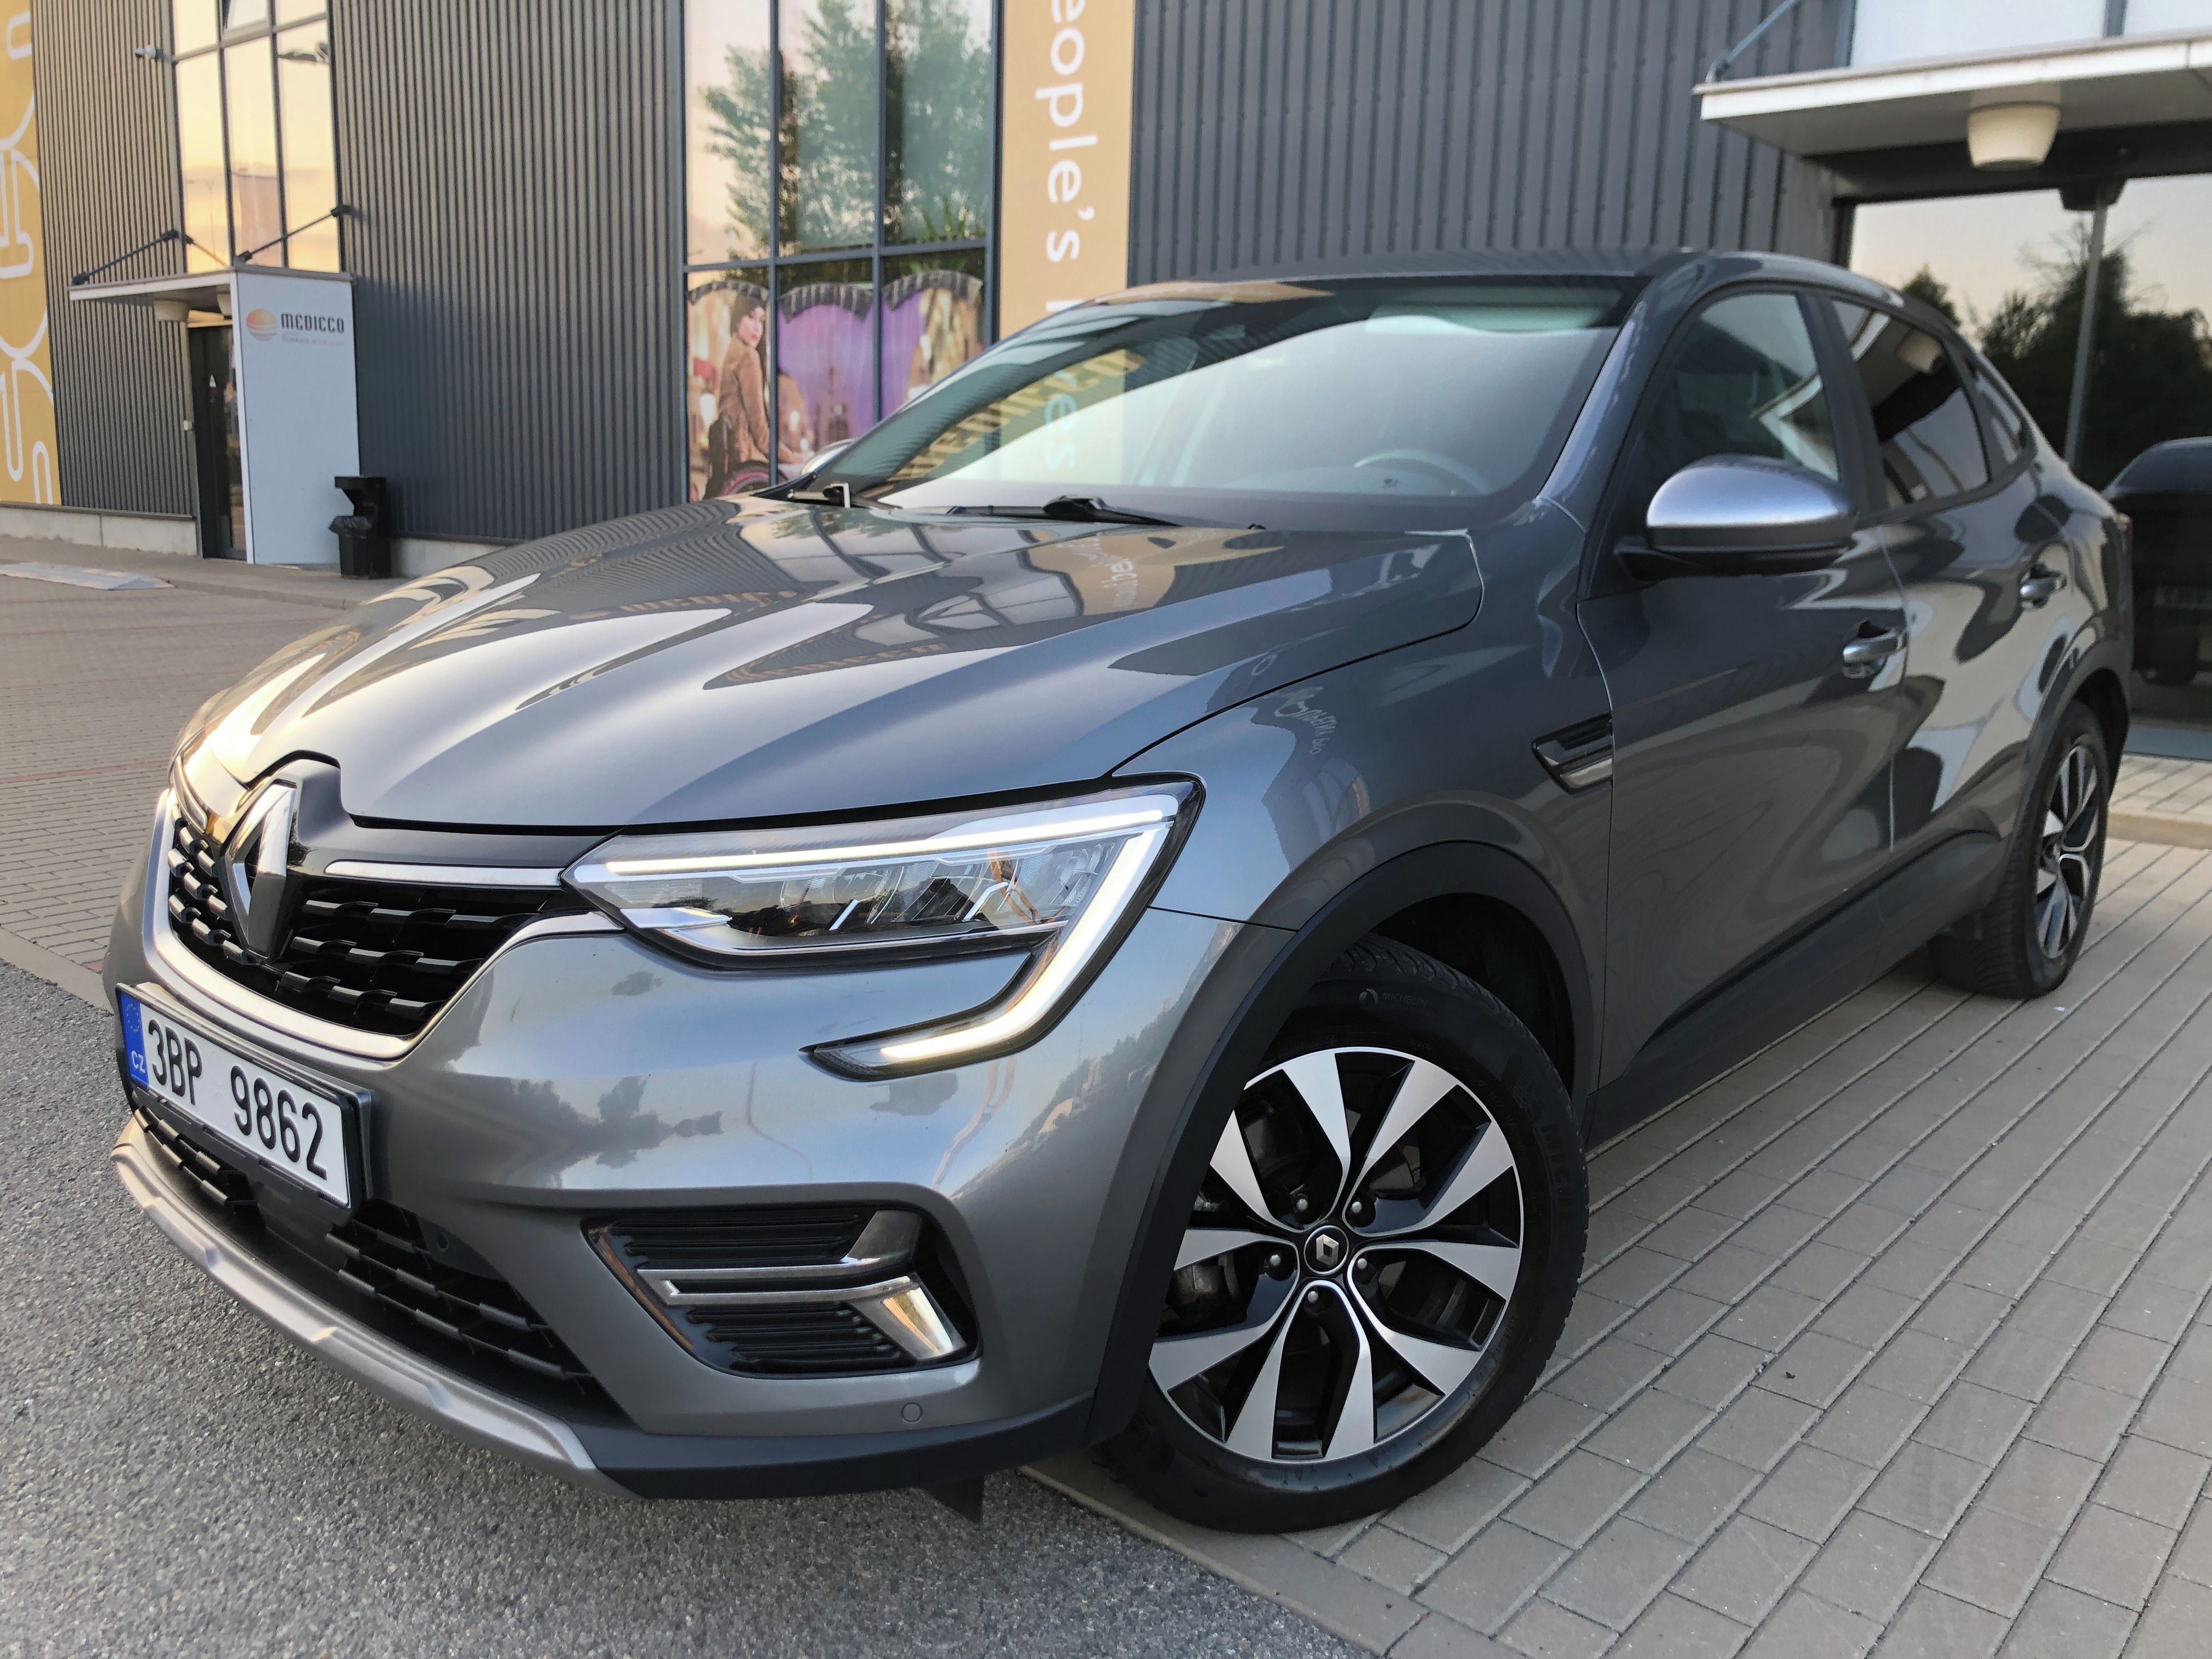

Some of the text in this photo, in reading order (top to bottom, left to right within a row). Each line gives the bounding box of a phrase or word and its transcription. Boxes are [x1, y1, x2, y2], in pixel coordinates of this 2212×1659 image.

[281, 313, 345, 333] MEDICCO
[1382, 992, 1428, 1007] MICHELIN
[131, 1049, 146, 1074] CZ
[148, 1019, 328, 1181] 3BP 9862
